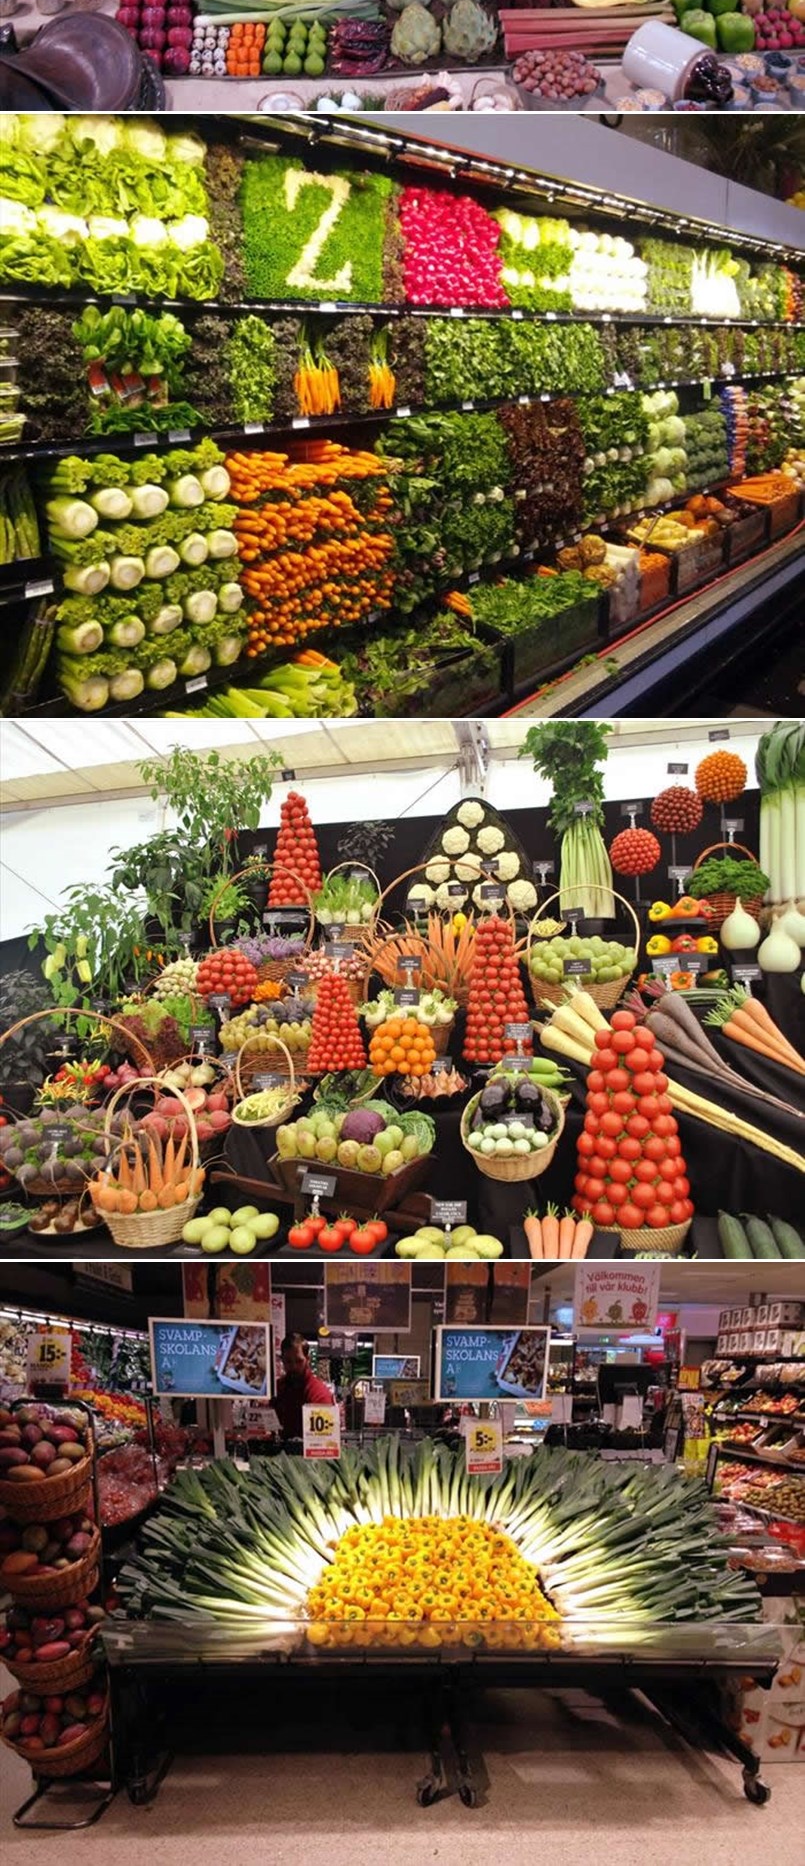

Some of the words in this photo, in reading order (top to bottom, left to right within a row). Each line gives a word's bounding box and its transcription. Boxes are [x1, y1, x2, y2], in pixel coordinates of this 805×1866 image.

[283, 168, 352, 294] Z
[586, 1270, 646, 1284] Välkommen
[586, 1282, 598, 1294] till
[600, 1282, 616, 1293] vår
[618, 1281, 648, 1295] klubb!
[158, 1329, 208, 1341] SVAMP-
[446, 1336, 491, 1347] SVAMP-
[40, 1344, 66, 1362] 15:-
[160, 1344, 216, 1355] SKOLANS
[446, 1350, 499, 1361] SKOLANS
[309, 1416, 334, 1432] 10:-
[476, 1431, 493, 1446] 5:-
